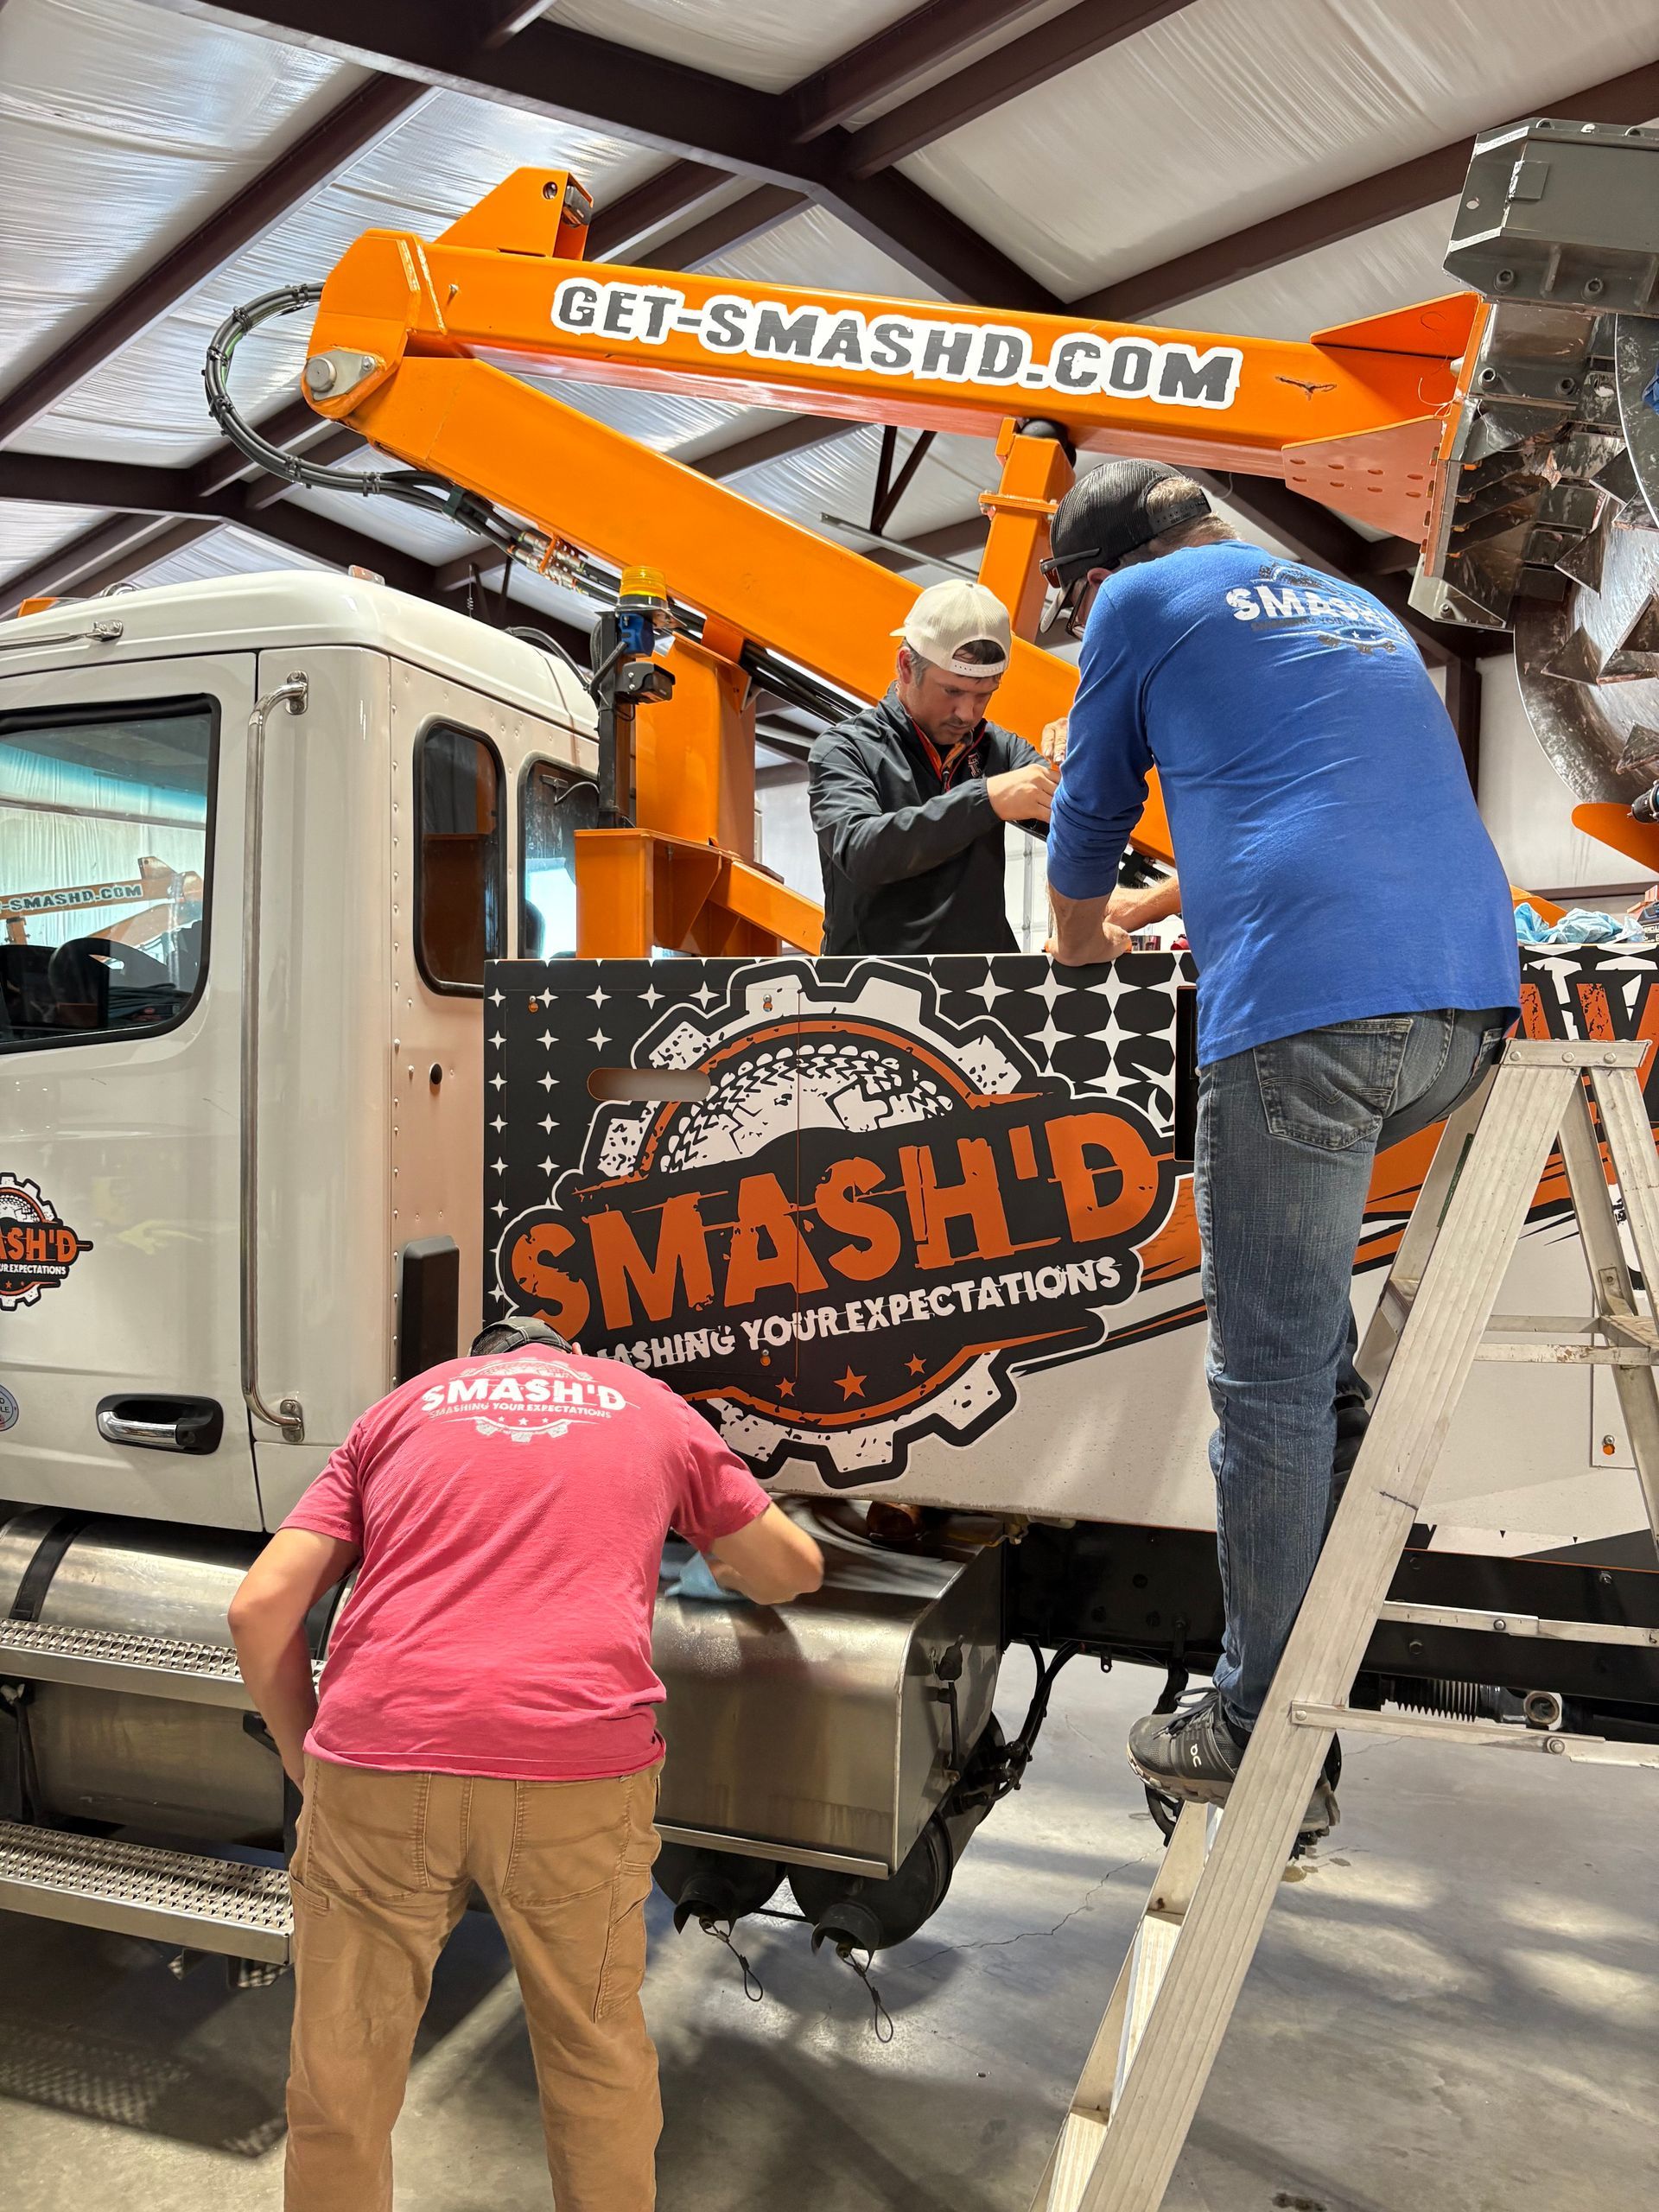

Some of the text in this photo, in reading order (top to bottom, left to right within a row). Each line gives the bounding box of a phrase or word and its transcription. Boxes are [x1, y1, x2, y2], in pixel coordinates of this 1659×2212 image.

[559, 285, 1234, 402] GET-SMASHD.COM
[512, 1112, 1159, 1340] SMASH'D
[10, 1263, 67, 1275] EXPECTATIONS
[596, 1255, 1122, 1370] ASHING YOUR EXPECTATIONS
[422, 1377, 626, 1411] SMASH'D
[429, 1402, 612, 1419] SMASHING YOUR EXPECTATIONS
